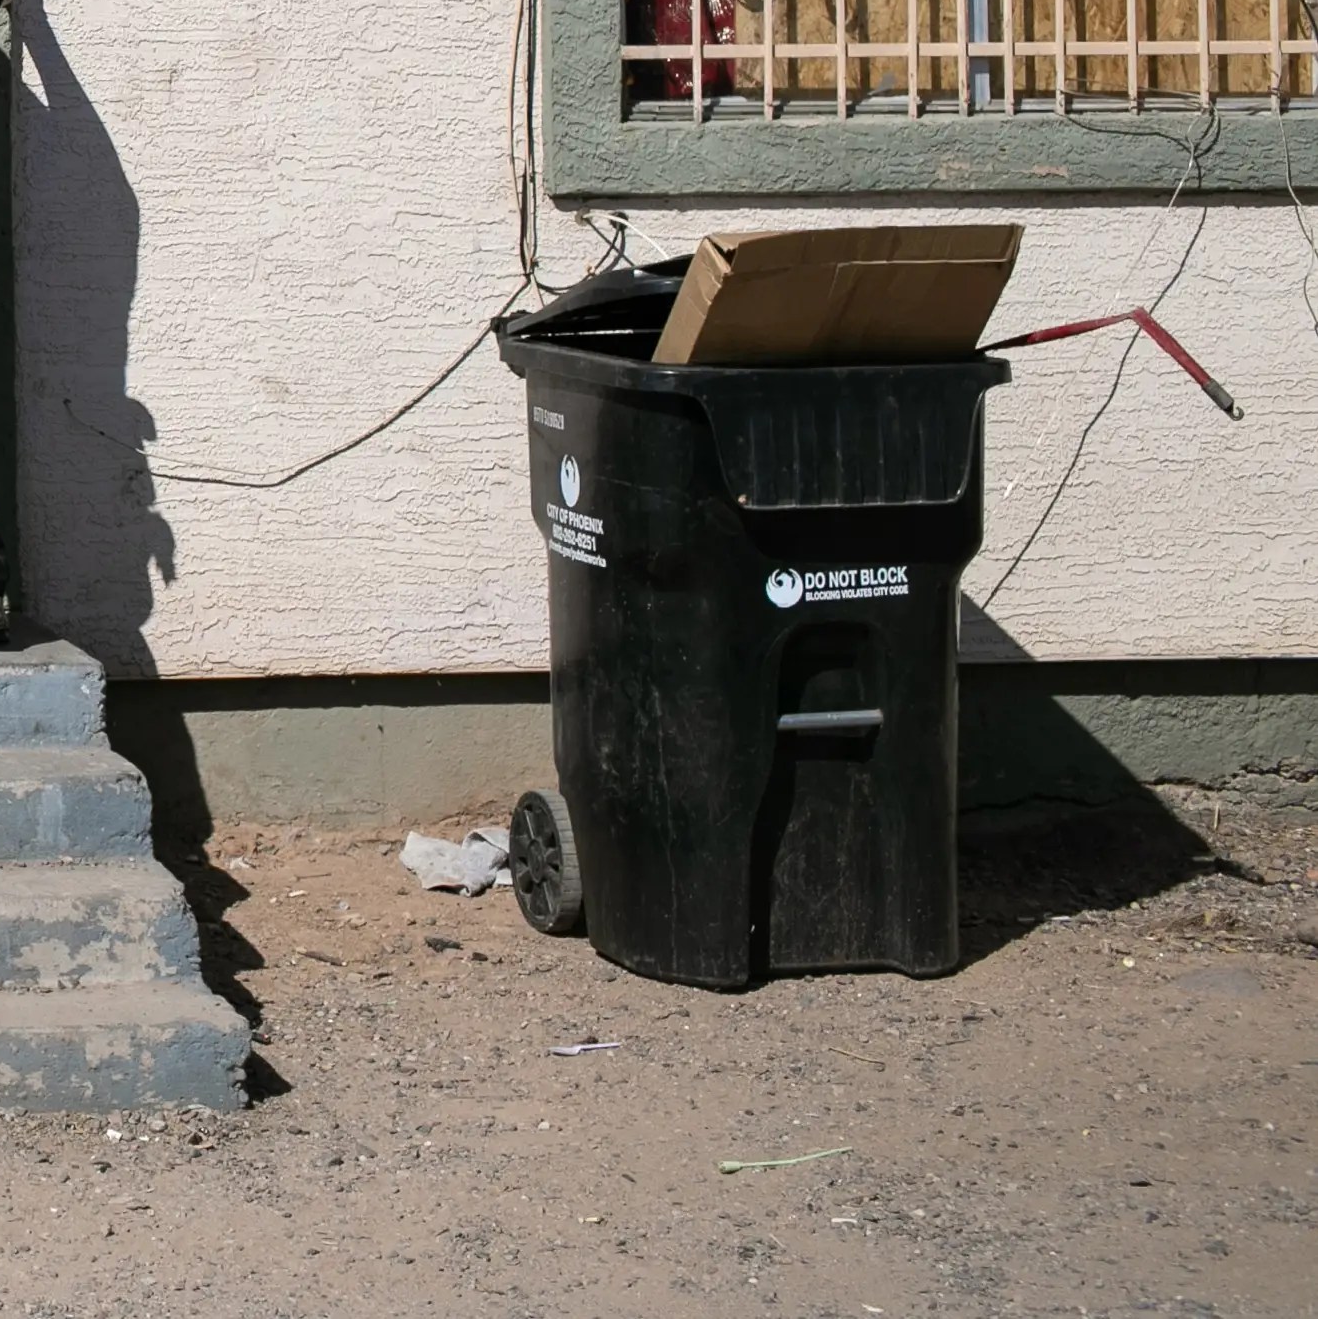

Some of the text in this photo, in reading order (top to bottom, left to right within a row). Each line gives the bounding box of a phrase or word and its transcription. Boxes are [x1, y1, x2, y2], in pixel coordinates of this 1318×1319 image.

[546, 502, 604, 535] CITY OF PHOENIX
[804, 565, 909, 590] DO NOT BLOCK
[805, 584, 909, 602] BLOCKING VIOLATES CITY CODE
